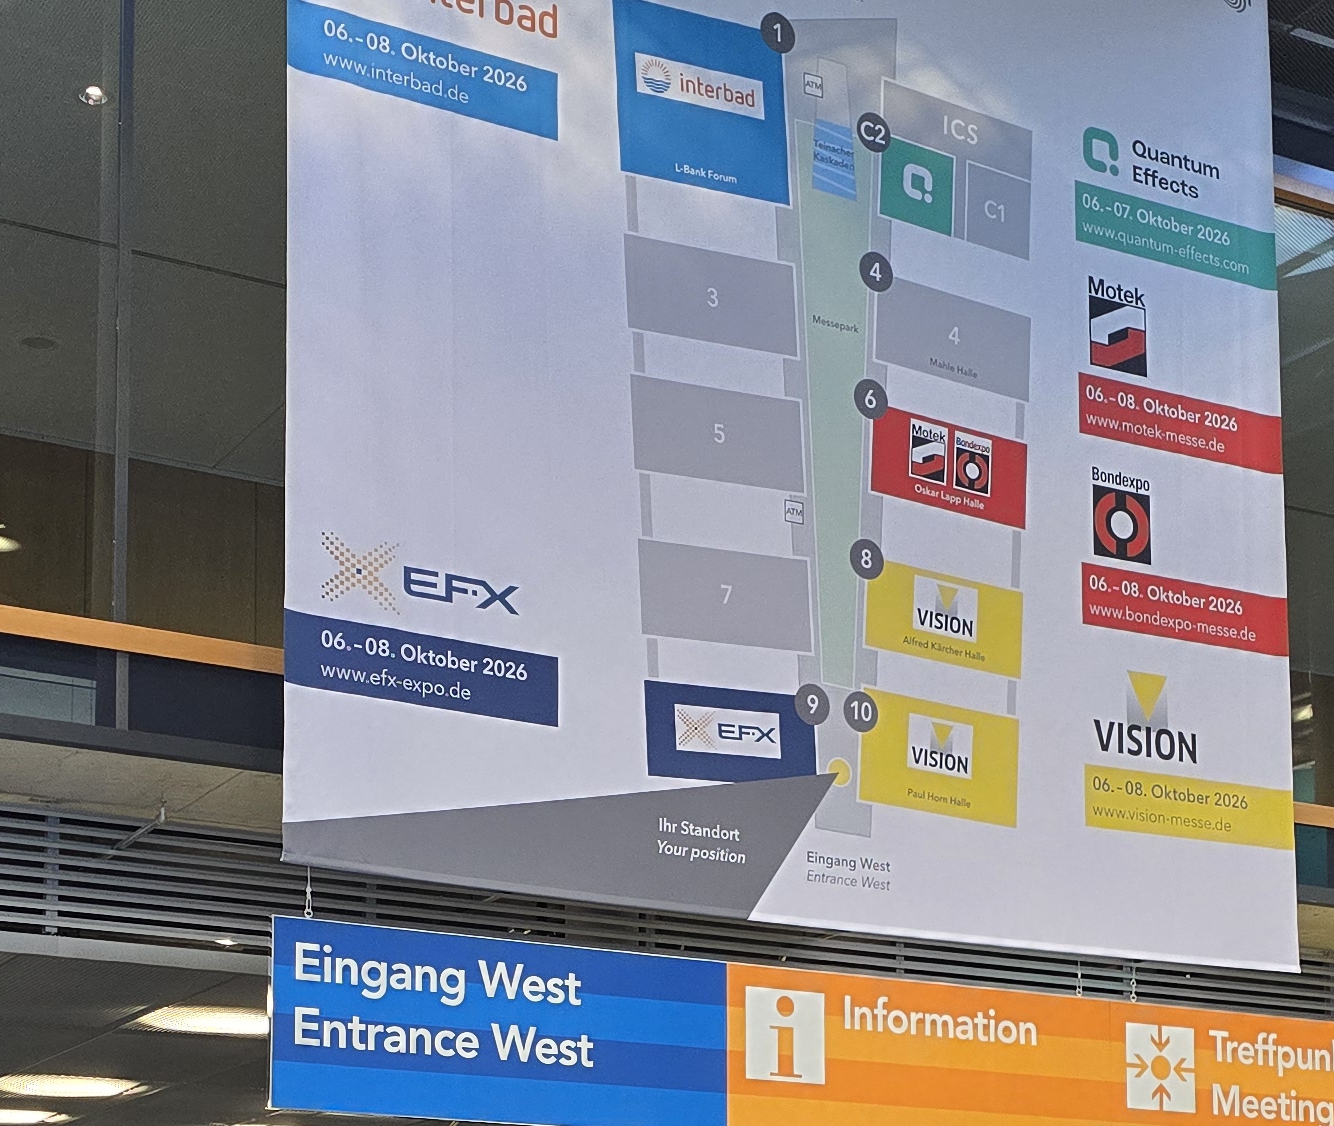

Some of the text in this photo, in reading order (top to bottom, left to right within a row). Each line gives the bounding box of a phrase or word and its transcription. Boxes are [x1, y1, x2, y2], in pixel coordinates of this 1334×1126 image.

[323, 52, 469, 104] www.interbad.de
[401, 43, 528, 93] Oktober 2026
[679, 75, 756, 109] interbad
[860, 120, 886, 144] C2
[943, 114, 979, 144] ICS
[675, 162, 737, 185] L-Bank Forum
[1131, 139, 1221, 180] Quantum
[1131, 165, 1200, 199] Effects
[984, 200, 1006, 223] C1
[1137, 208, 1231, 246] Oktober 2026
[1082, 222, 1250, 275] www.quantum-effects.com
[1088, 275, 1146, 307] Motek
[812, 315, 859, 335] Messepark
[929, 357, 978, 379] Mahle Halle
[1143, 398, 1238, 432] Oktober 2026
[911, 423, 946, 443] Motek
[955, 437, 991, 454] Bondexpo
[1085, 411, 1226, 454] www.motek-messe.de
[1091, 466, 1150, 492] Bondexpo
[914, 484, 985, 511] Oskar Halle
[917, 607, 974, 638] VISION
[1088, 603, 1257, 643] www.bondexpo-messe.de
[903, 636, 985, 662] Alfred Kärcher Halle
[320, 662, 471, 702] www.efx-expo.de
[850, 702, 872, 720] 10
[1094, 719, 1198, 764] VISION
[912, 746, 969, 774] VISION
[907, 788, 948, 804] Paul Horn
[658, 818, 740, 842] Ihr Standort
[1093, 805, 1232, 832] www.vision-messe.de
[657, 840, 746, 865] Your position
[806, 851, 891, 873] Eingang West
[806, 870, 891, 891] Entrance West
[294, 941, 582, 1007] Eingang West
[844, 995, 1037, 1047] Information
[293, 1006, 594, 1069] Entrance West
